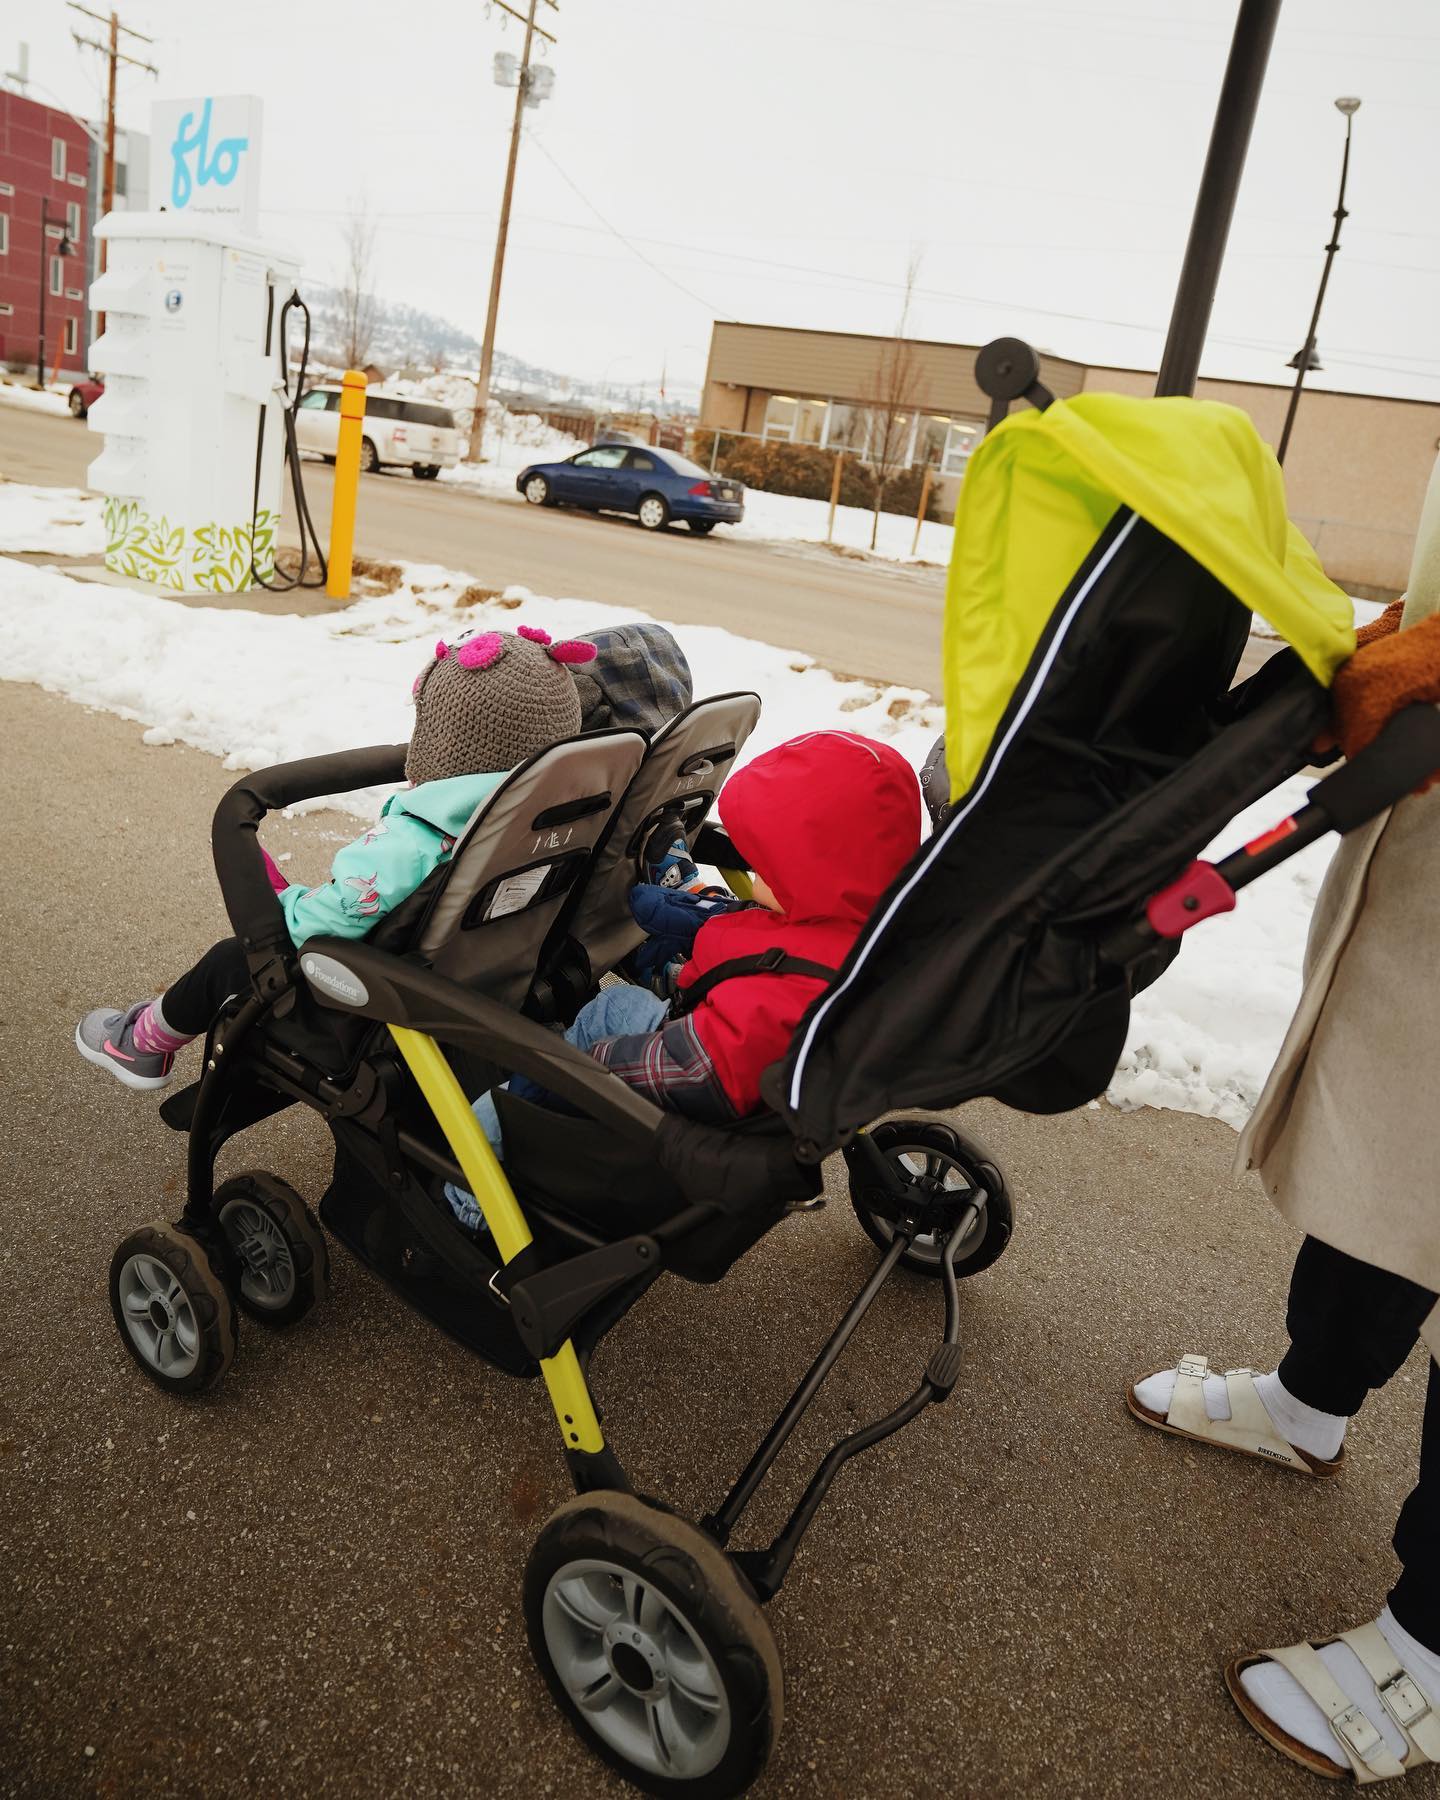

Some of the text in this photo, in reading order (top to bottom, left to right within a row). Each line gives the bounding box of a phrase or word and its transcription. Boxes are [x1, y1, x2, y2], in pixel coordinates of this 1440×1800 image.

[170, 97, 248, 208] flo
[315, 966, 357, 997] Foundations
[1257, 1446, 1292, 1462] BIRKENSTOCK
